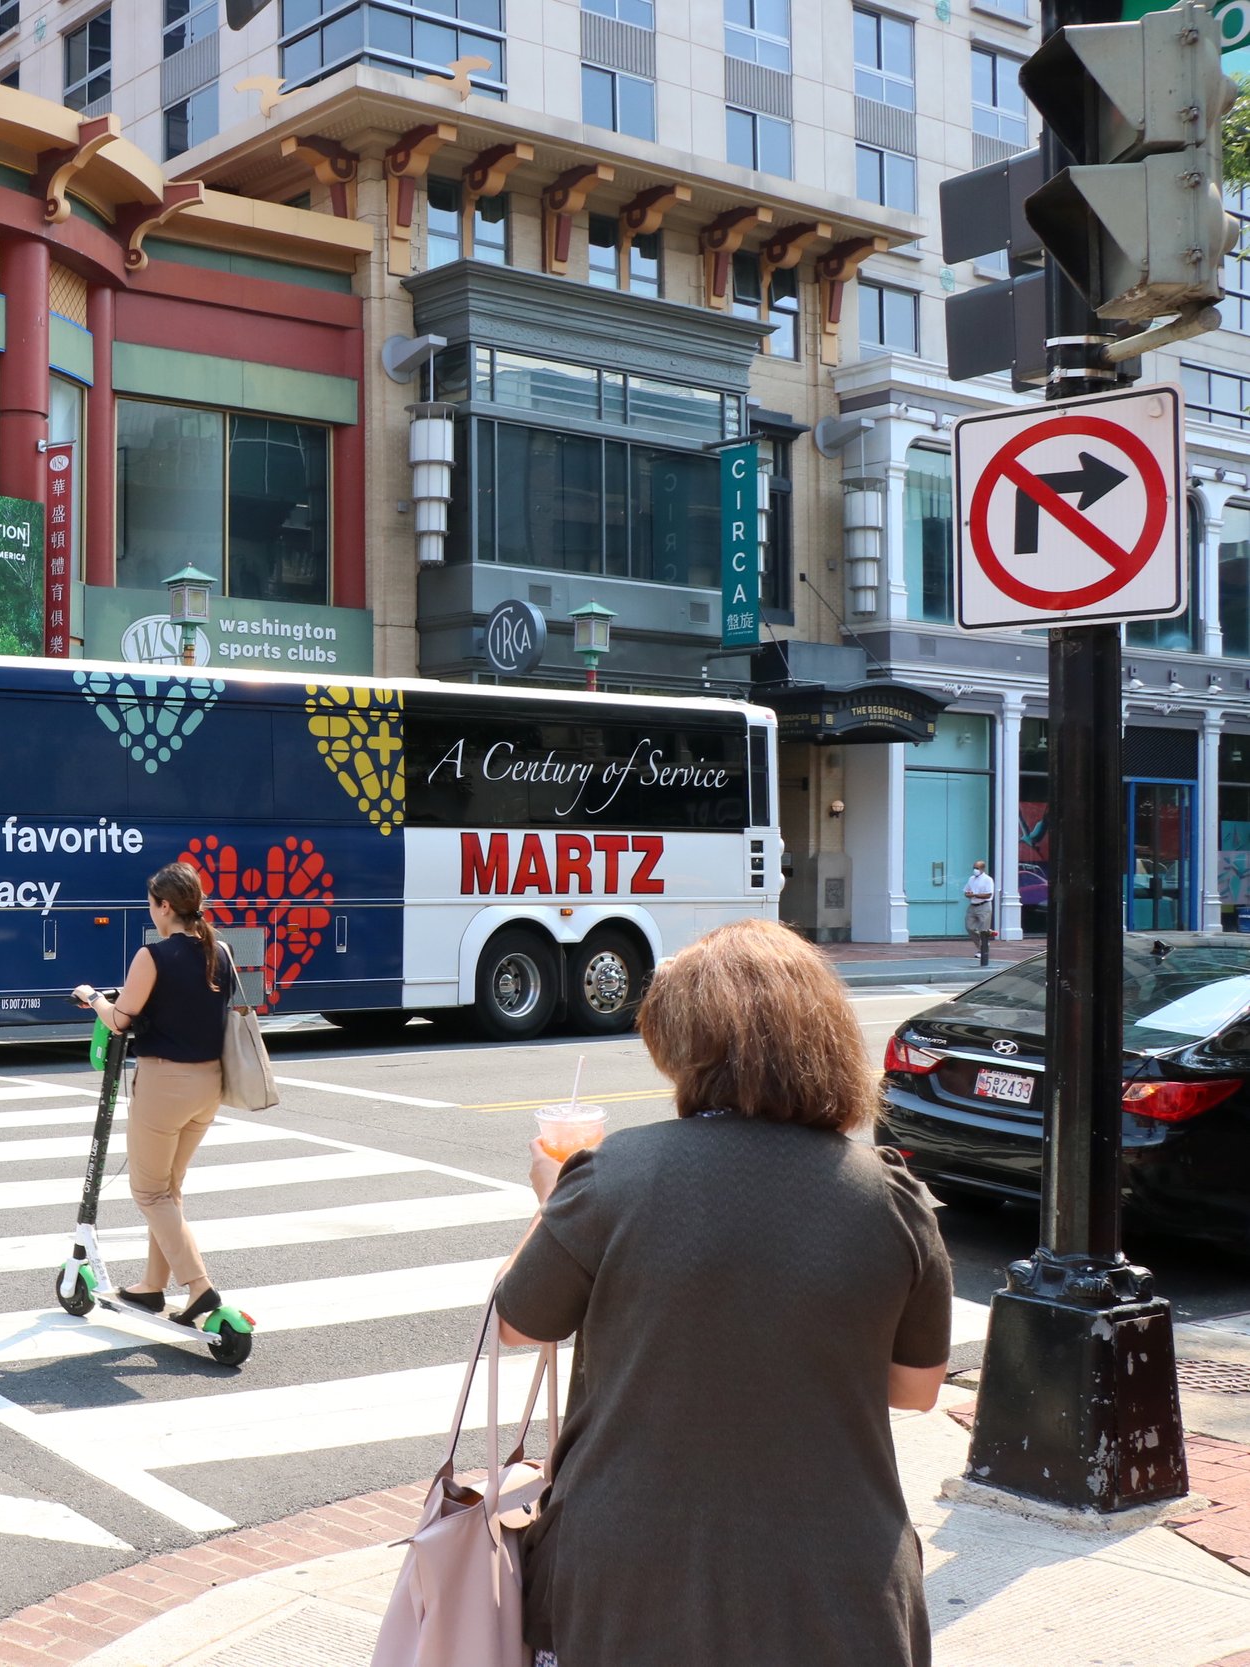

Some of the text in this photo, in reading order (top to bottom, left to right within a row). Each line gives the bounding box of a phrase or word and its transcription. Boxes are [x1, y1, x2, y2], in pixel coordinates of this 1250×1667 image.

[732, 459, 747, 605] CIRCA
[219, 618, 337, 642] washington
[488, 606, 532, 671] CIRCA
[219, 640, 337, 663] sports clubs
[851, 706, 867, 717] THE
[867, 705, 913, 722] RESIDENCES
[427, 738, 466, 784] A
[482, 741, 594, 816] Century
[586, 738, 651, 815] of
[640, 749, 729, 789] Service
[2, 815, 144, 854] favorite
[460, 831, 665, 896] MARTZ
[1, 998, 9, 1010] US
[9, 998, 21, 1010] DOT
[21, 997, 41, 1010] 271803
[910, 1034, 948, 1046] SONATA
[87, 1163, 95, 1183] Lime
